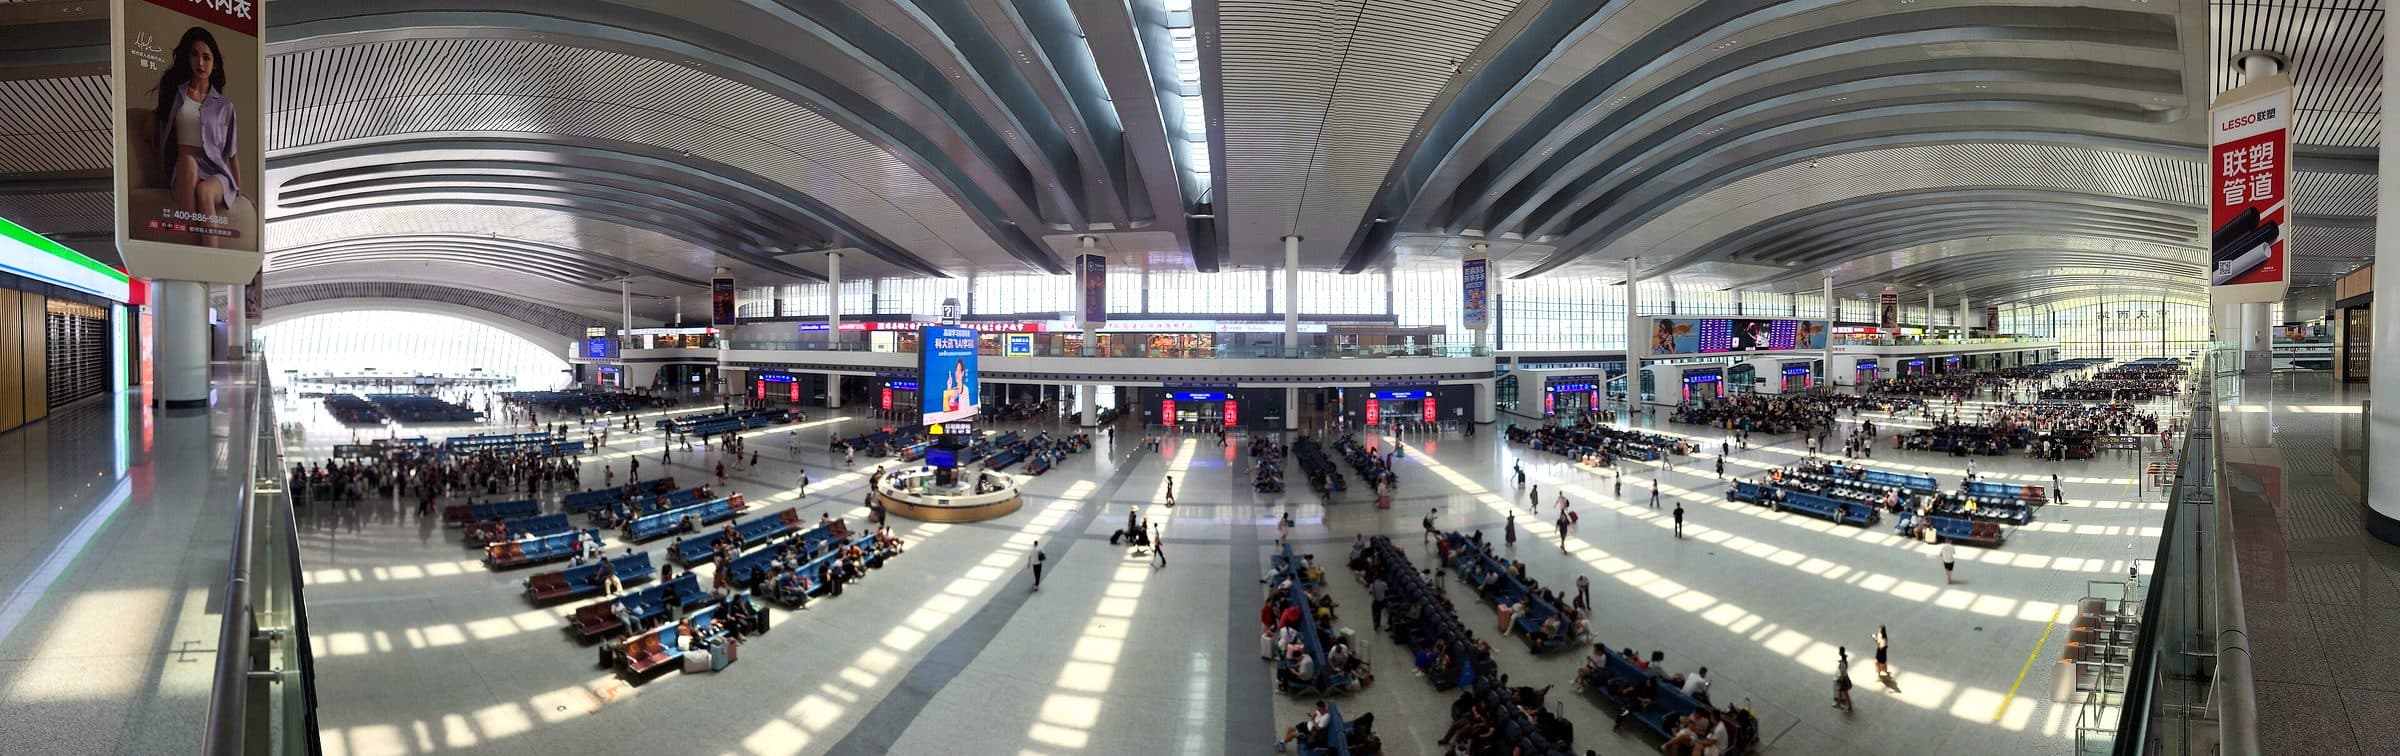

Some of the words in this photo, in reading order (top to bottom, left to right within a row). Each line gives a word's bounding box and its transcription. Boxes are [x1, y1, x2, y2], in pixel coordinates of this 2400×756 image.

[2222, 113, 2256, 131] LESSO
[2256, 107, 2276, 122] 联塑
[2223, 141, 2274, 177] 联塑
[2223, 172, 2274, 207] 管道
